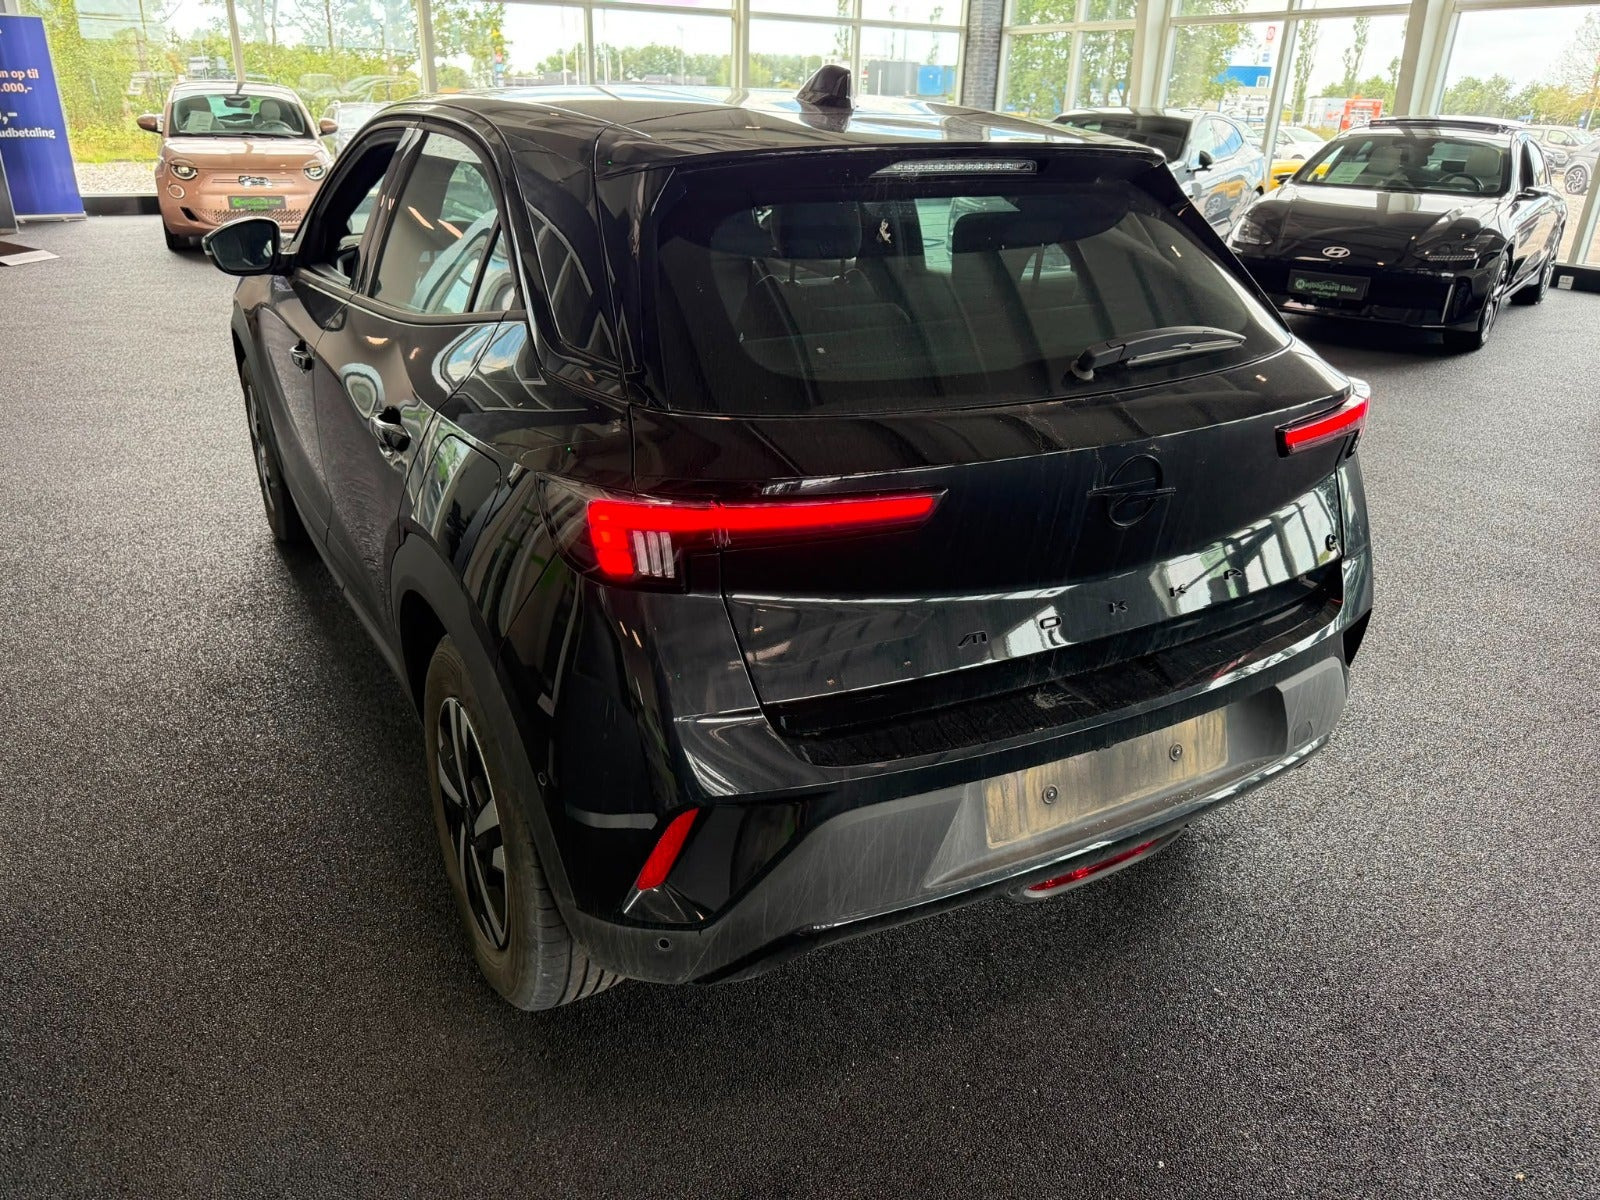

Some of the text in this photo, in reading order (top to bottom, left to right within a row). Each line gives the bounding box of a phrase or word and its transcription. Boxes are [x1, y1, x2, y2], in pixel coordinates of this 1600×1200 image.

[11, 71, 25, 80] op
[27, 69, 39, 79] til
[0, 127, 56, 139] udbetaling
